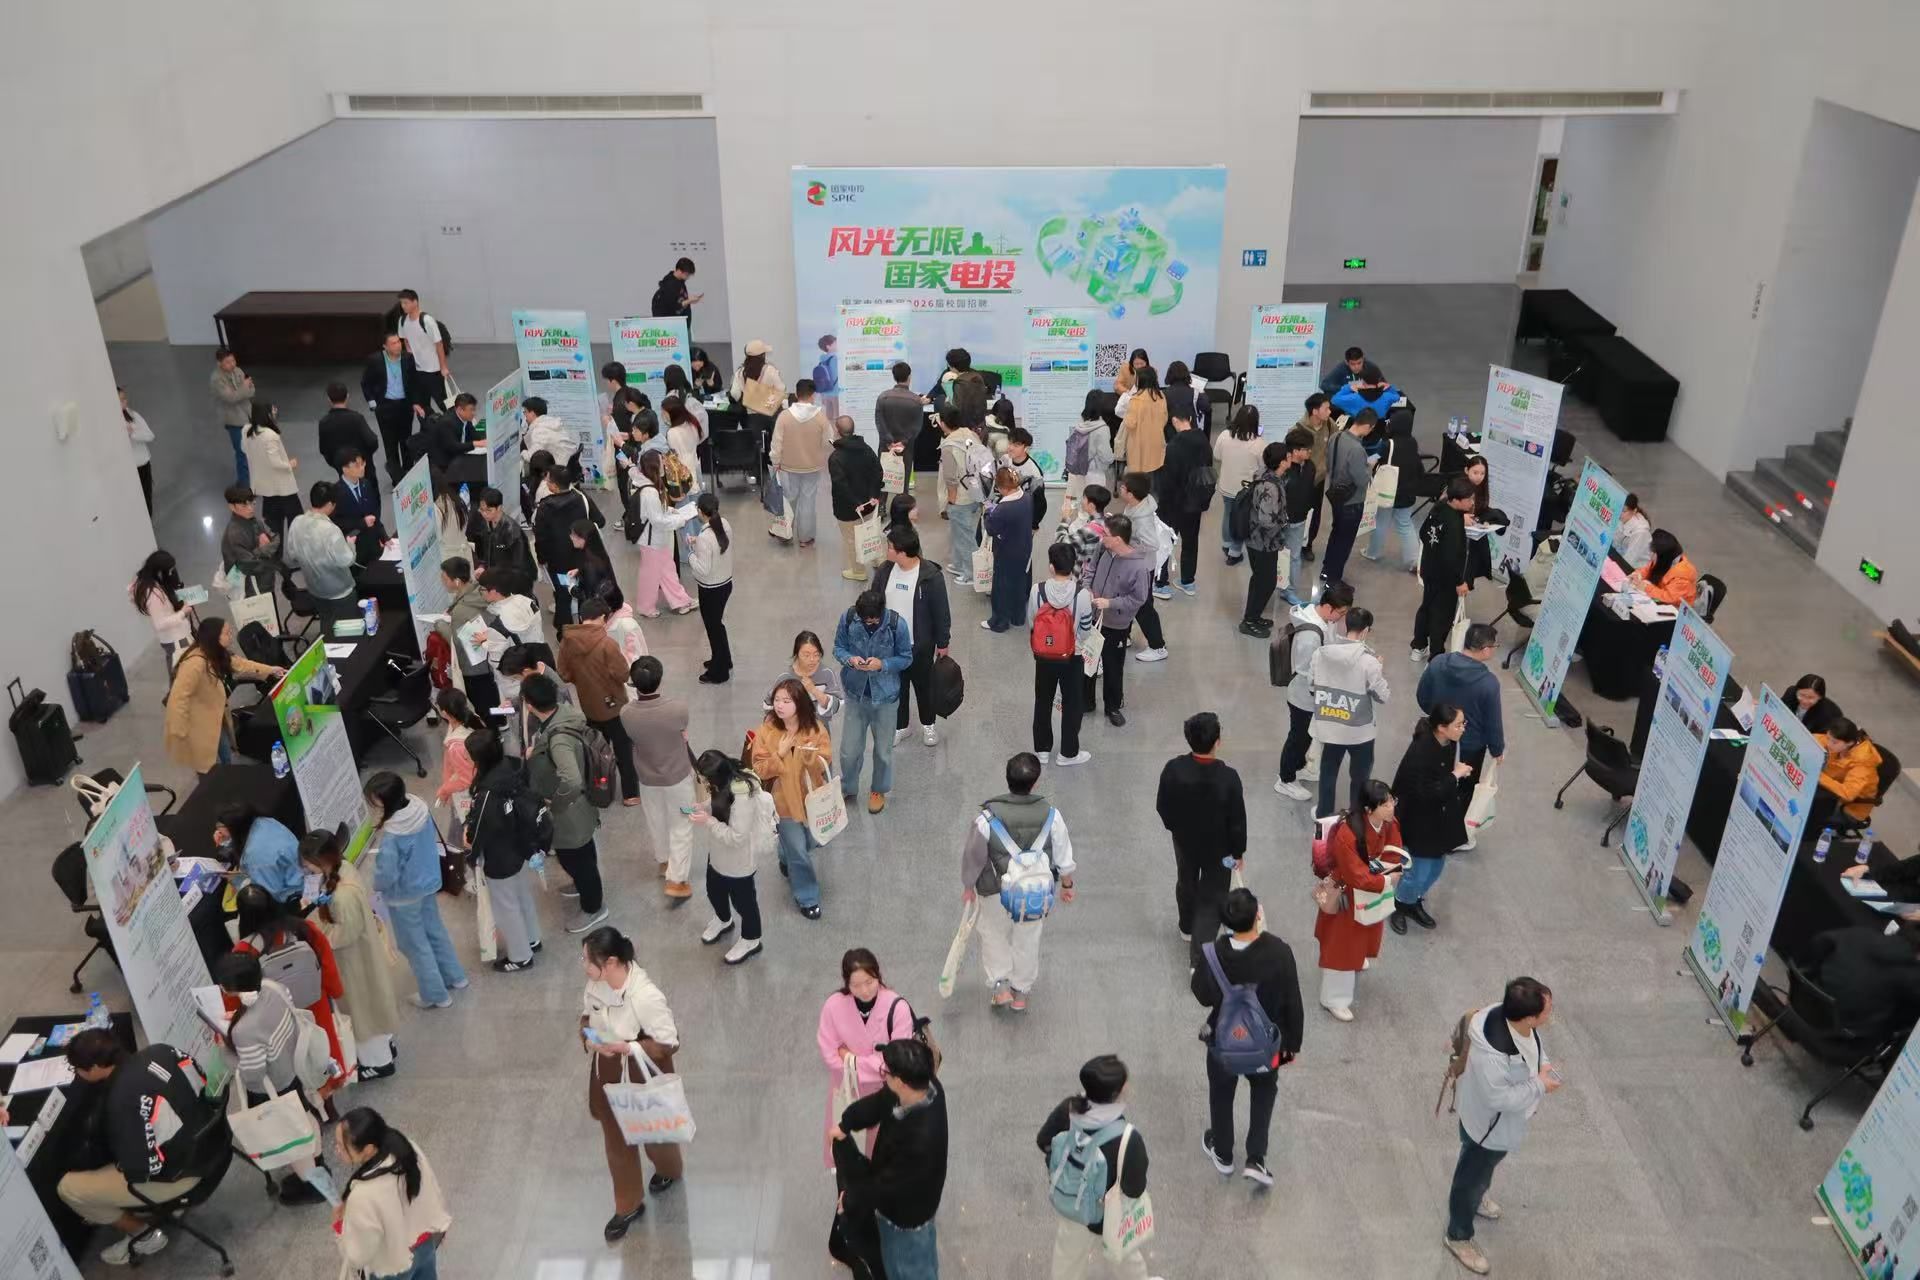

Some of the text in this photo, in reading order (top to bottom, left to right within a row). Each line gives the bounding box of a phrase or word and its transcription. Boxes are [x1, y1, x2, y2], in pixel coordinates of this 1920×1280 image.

[831, 194, 857, 203] SPIC
[828, 226, 965, 258] 风光无限
[884, 260, 1016, 289] 国家电投
[1315, 690, 1360, 713] PLAY
[1320, 706, 1351, 720] HARD
